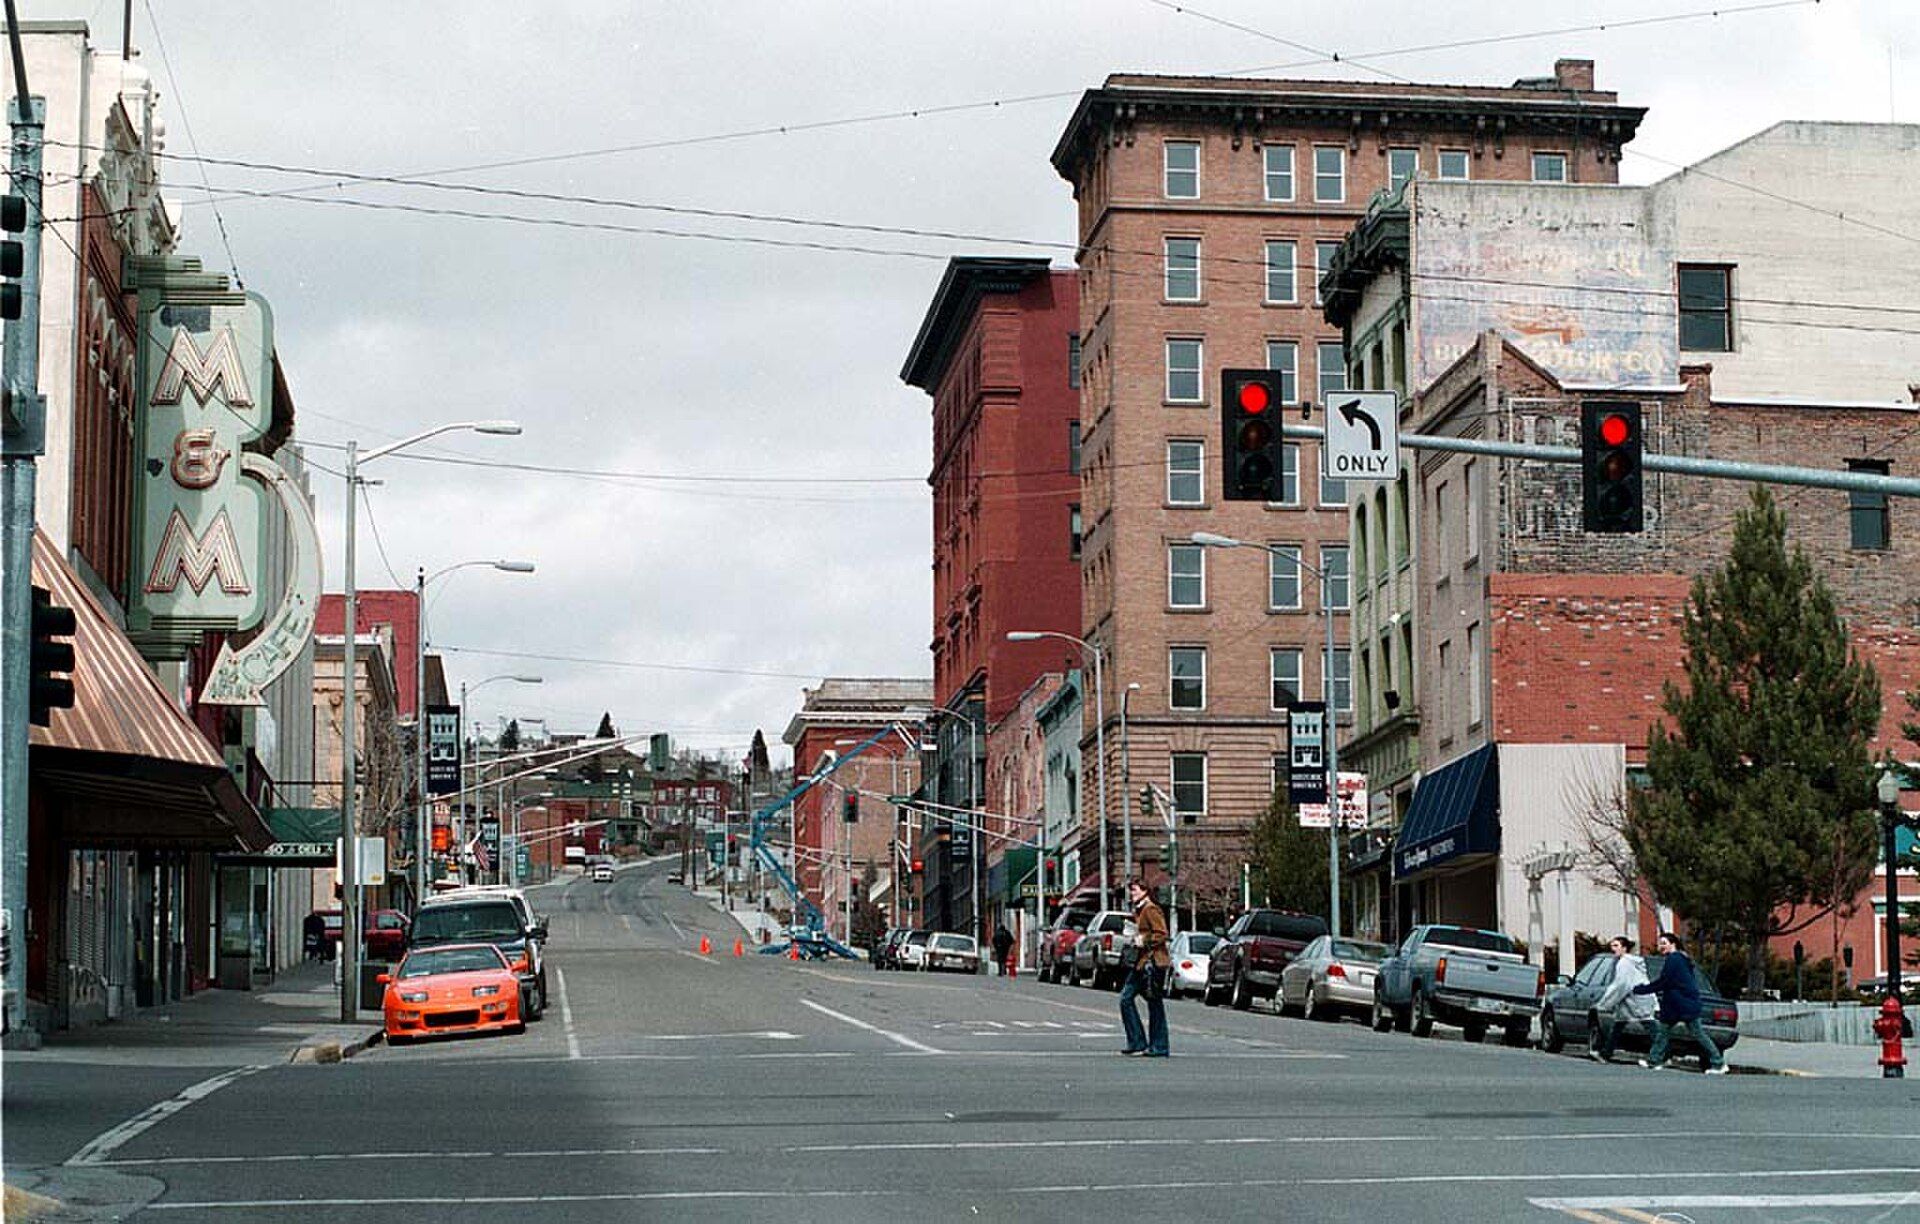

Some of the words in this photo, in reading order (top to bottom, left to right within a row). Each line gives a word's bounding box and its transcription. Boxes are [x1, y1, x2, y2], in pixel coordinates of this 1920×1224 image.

[150, 323, 255, 410] M
[170, 427, 231, 490] &
[1336, 454, 1389, 473] ONLY
[143, 503, 252, 598] M
[241, 610, 311, 685] CAFE
